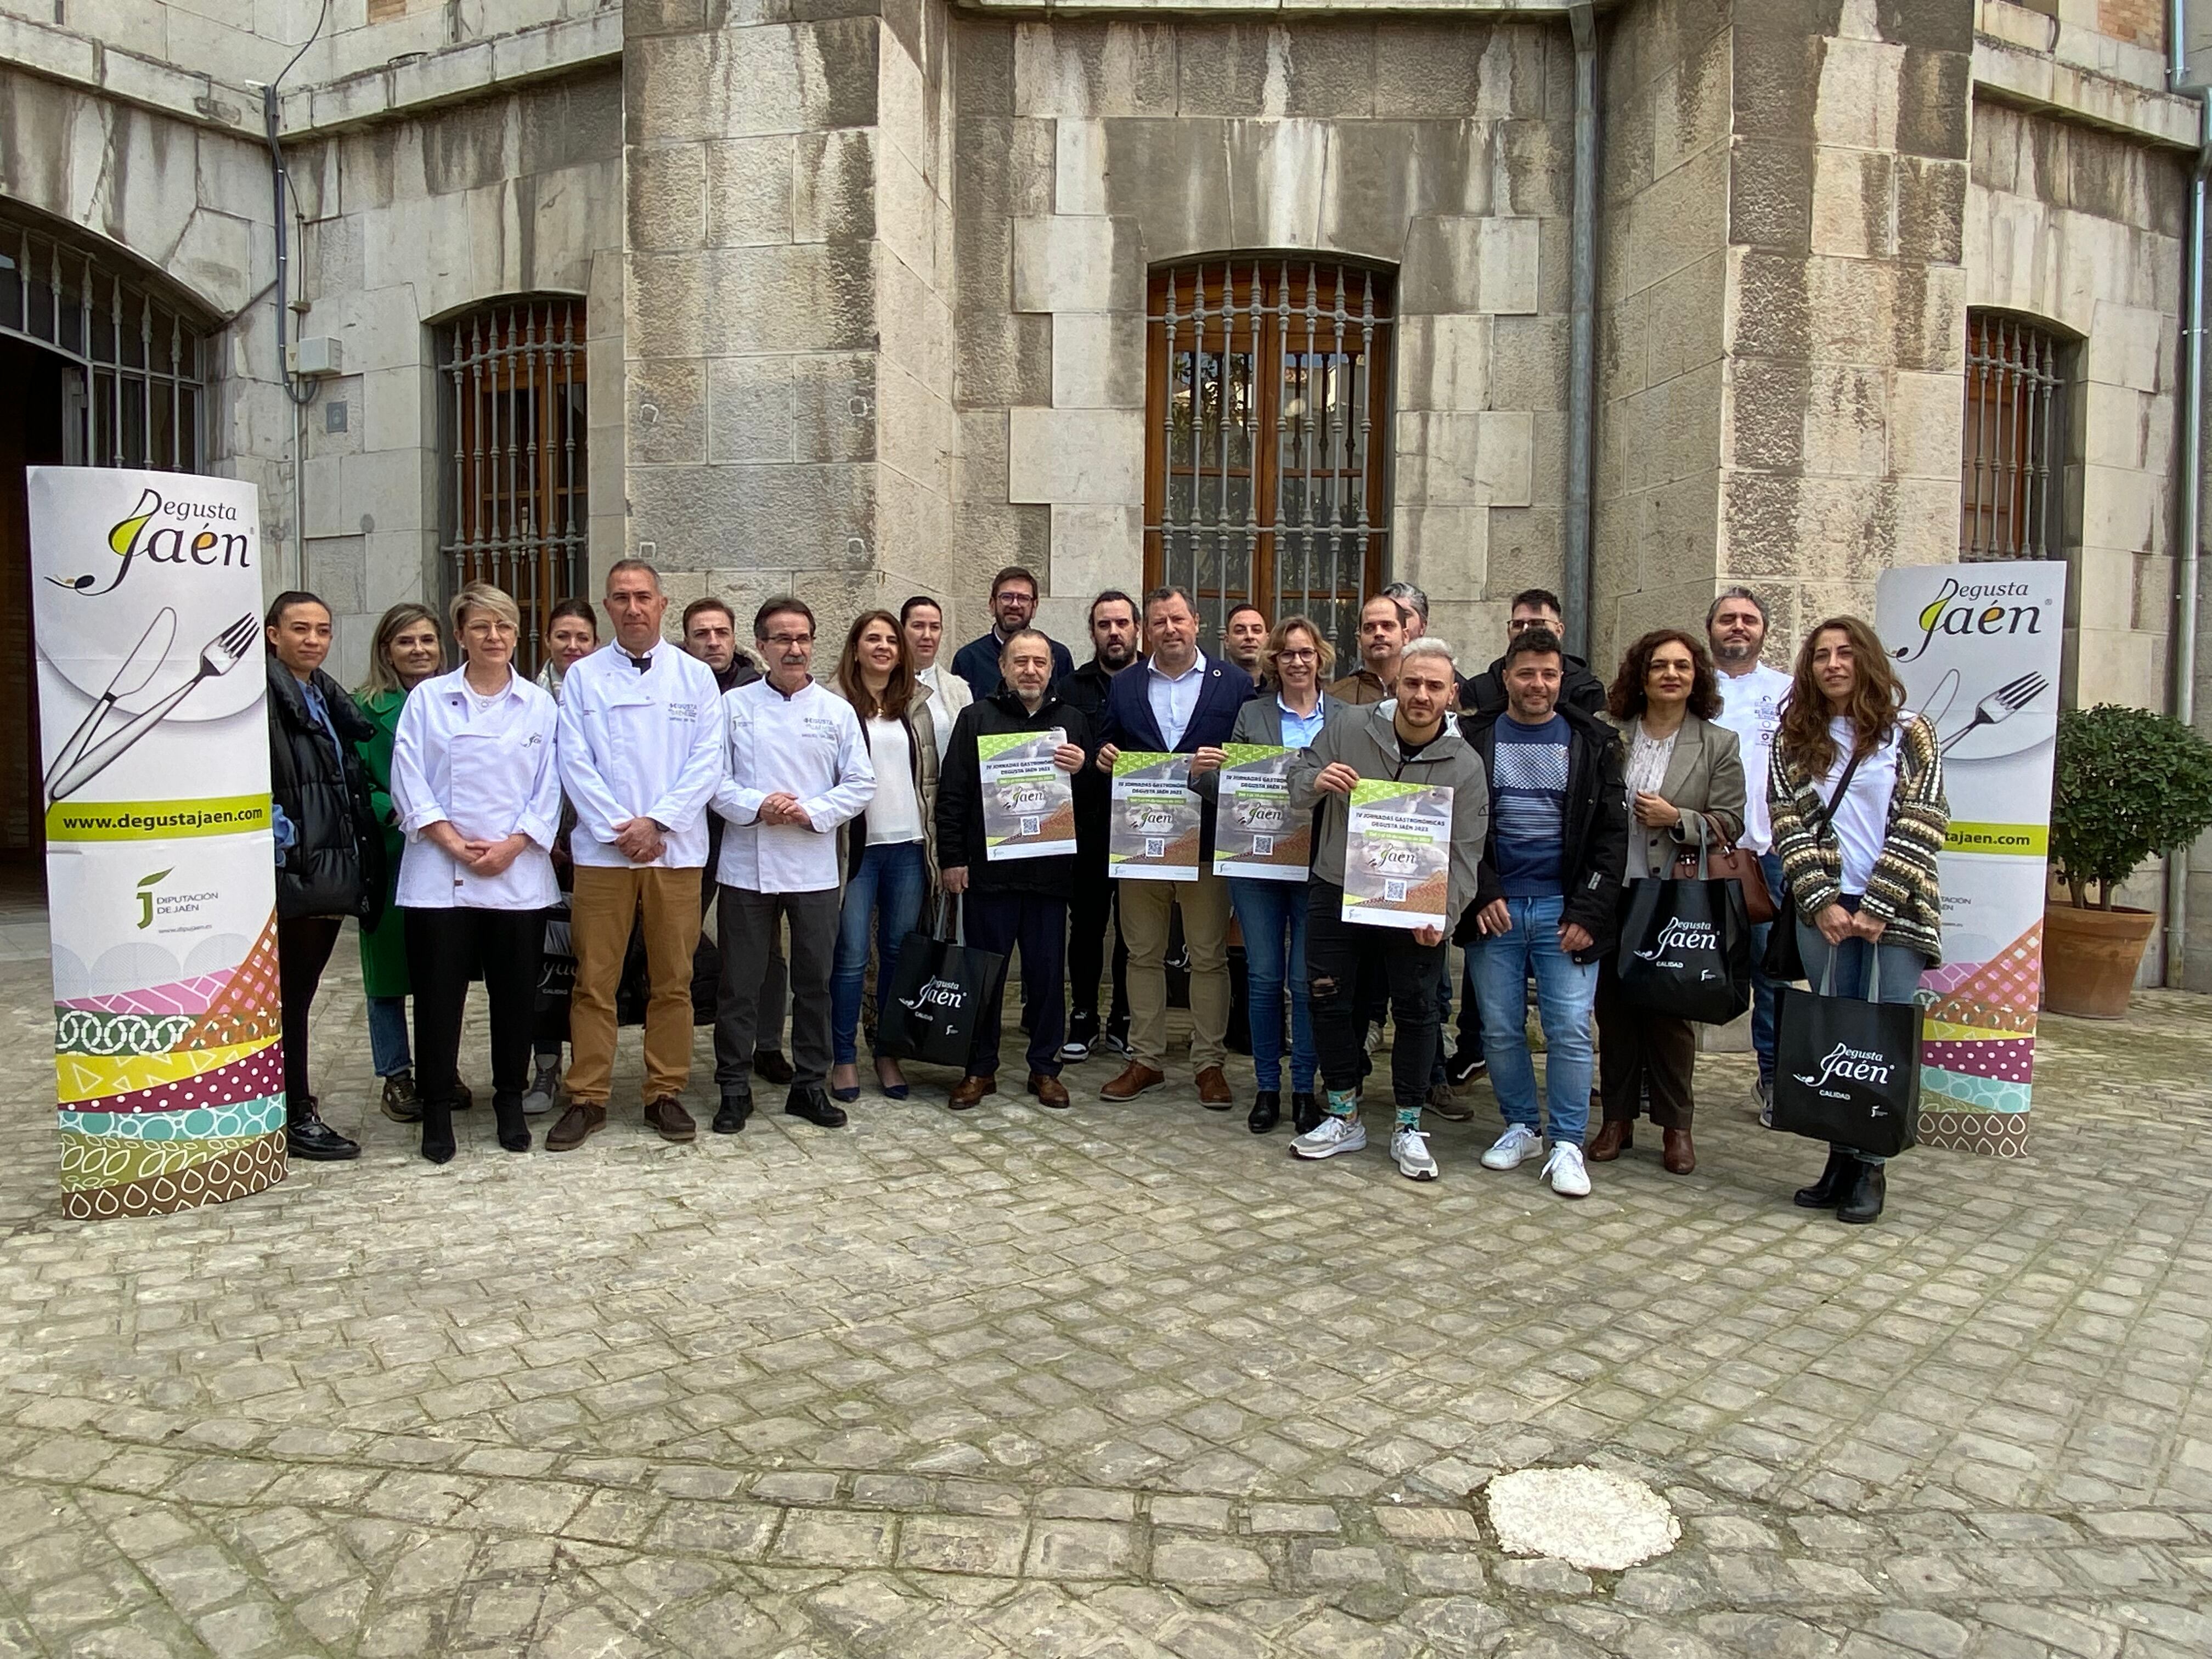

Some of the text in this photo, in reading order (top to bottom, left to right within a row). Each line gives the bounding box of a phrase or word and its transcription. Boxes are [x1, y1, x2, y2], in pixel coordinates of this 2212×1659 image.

[128, 488, 237, 521] Degusta
[76, 514, 251, 596] Jaén
[1934, 578, 2029, 601] Degusta
[1896, 599, 2042, 663] Jaén
[63, 808, 263, 831] www.degustajaen.com
[1944, 831, 2030, 846] tajaen.com
[157, 891, 219, 905] DIPUTACIÓN
[173, 904, 200, 913] JAÉN
[1666, 916, 1712, 930] Degusta
[1643, 928, 1717, 961] Jaén
[1656, 961, 1684, 969] CALIDAD
[906, 985, 962, 1009] Jaén
[1831, 1042, 1883, 1062] Degusta
[1805, 1056, 1888, 1087] Jaén
[1819, 1090, 1851, 1101] CALIDAD
